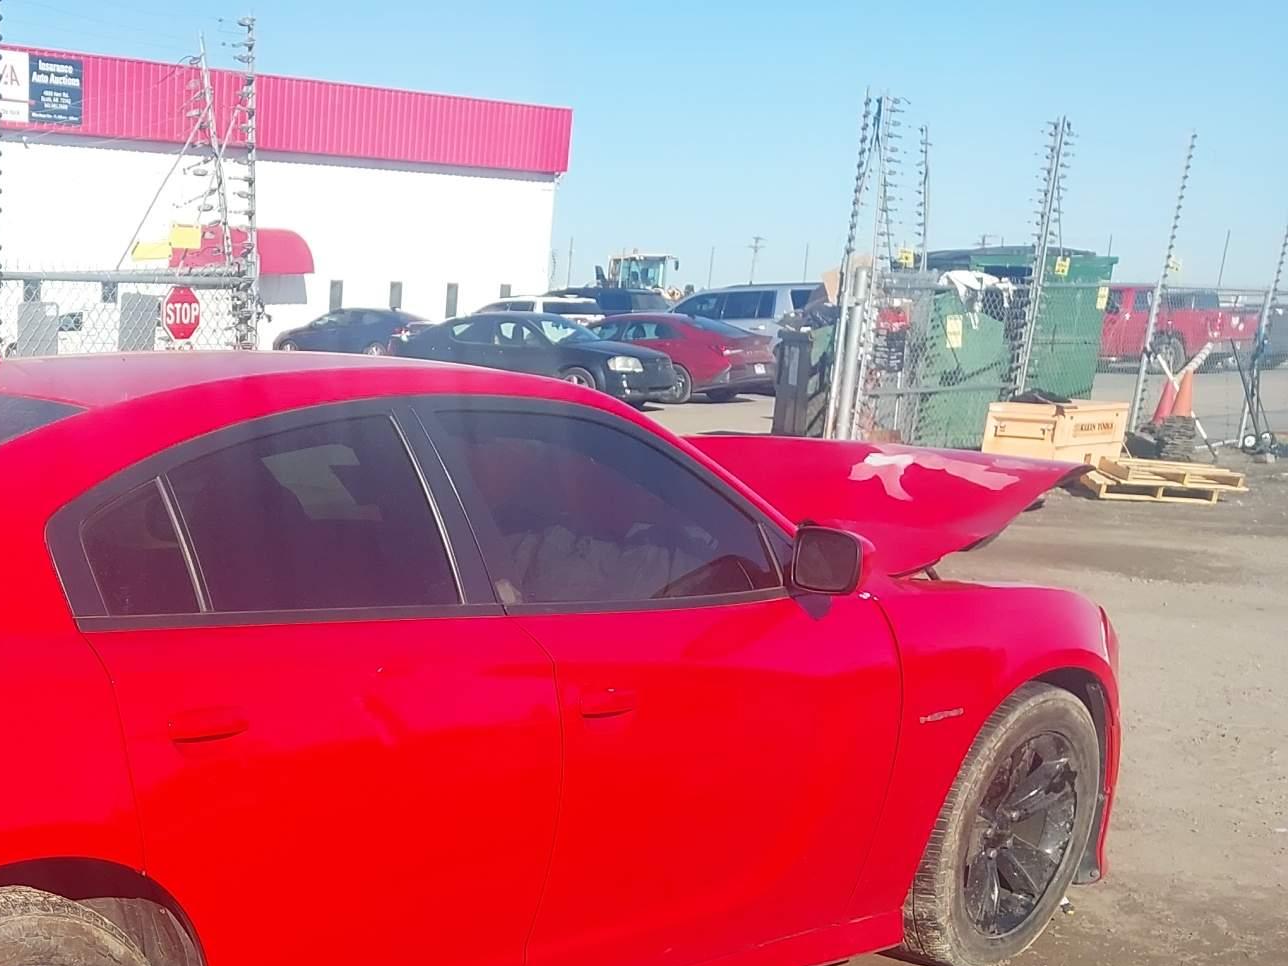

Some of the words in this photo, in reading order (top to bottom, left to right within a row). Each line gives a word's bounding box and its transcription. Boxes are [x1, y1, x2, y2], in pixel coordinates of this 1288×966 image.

[31, 71, 49, 84] Auto
[49, 73, 80, 87] Auctions
[166, 302, 200, 325] STOP
